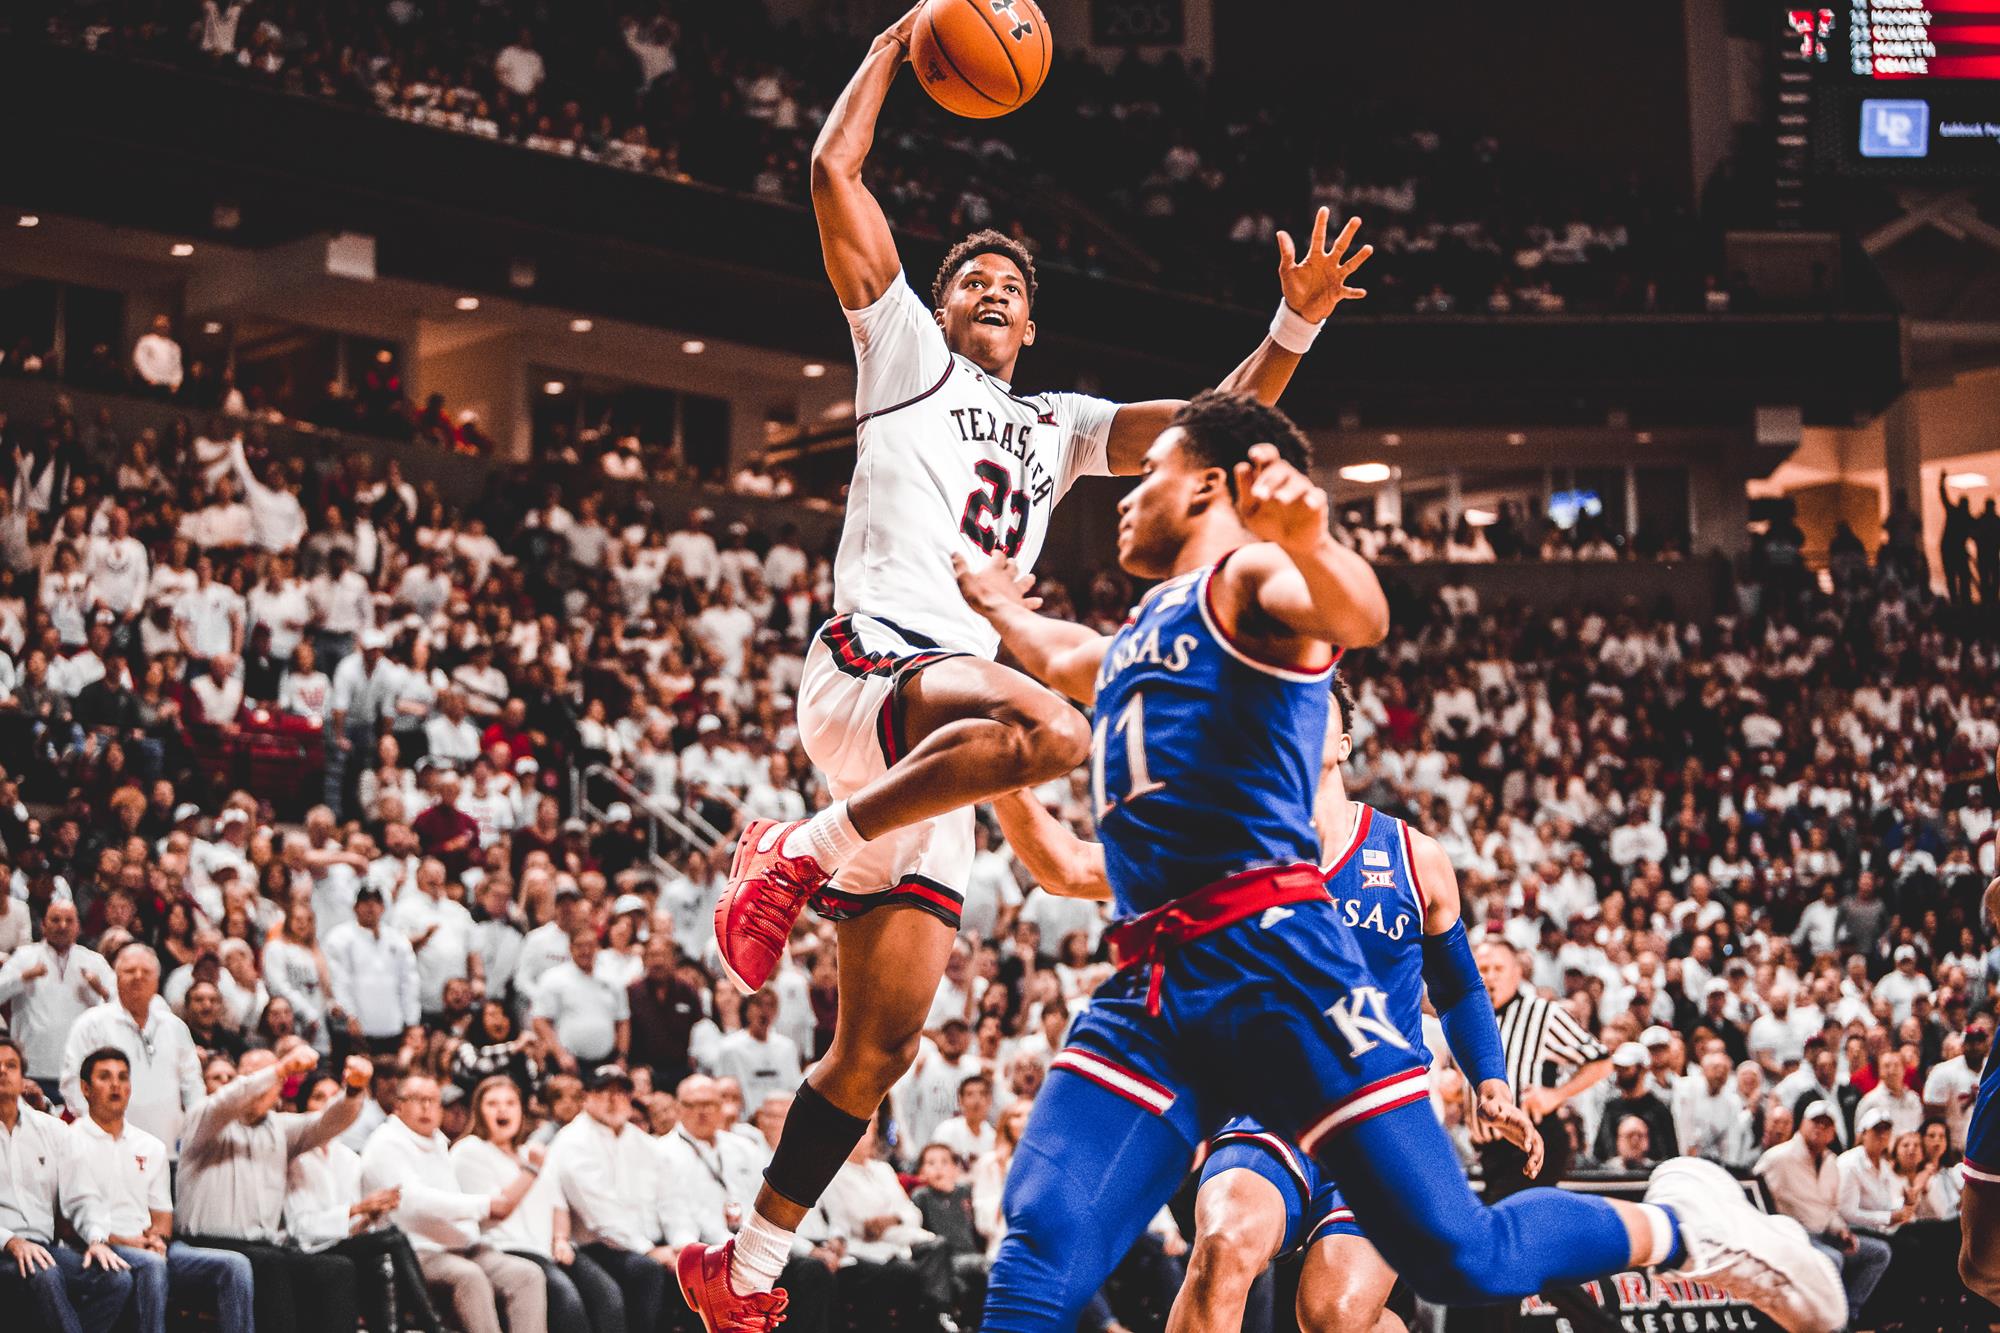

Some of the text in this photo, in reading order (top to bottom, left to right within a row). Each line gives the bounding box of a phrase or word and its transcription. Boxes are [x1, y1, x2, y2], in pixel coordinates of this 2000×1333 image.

[951, 407, 1033, 461] TEXAS
[960, 458, 1031, 558] 23
[1089, 690, 1166, 817] 11
[1329, 897, 1410, 941] SAS
[1556, 1309, 1758, 1333] BKETBALL
